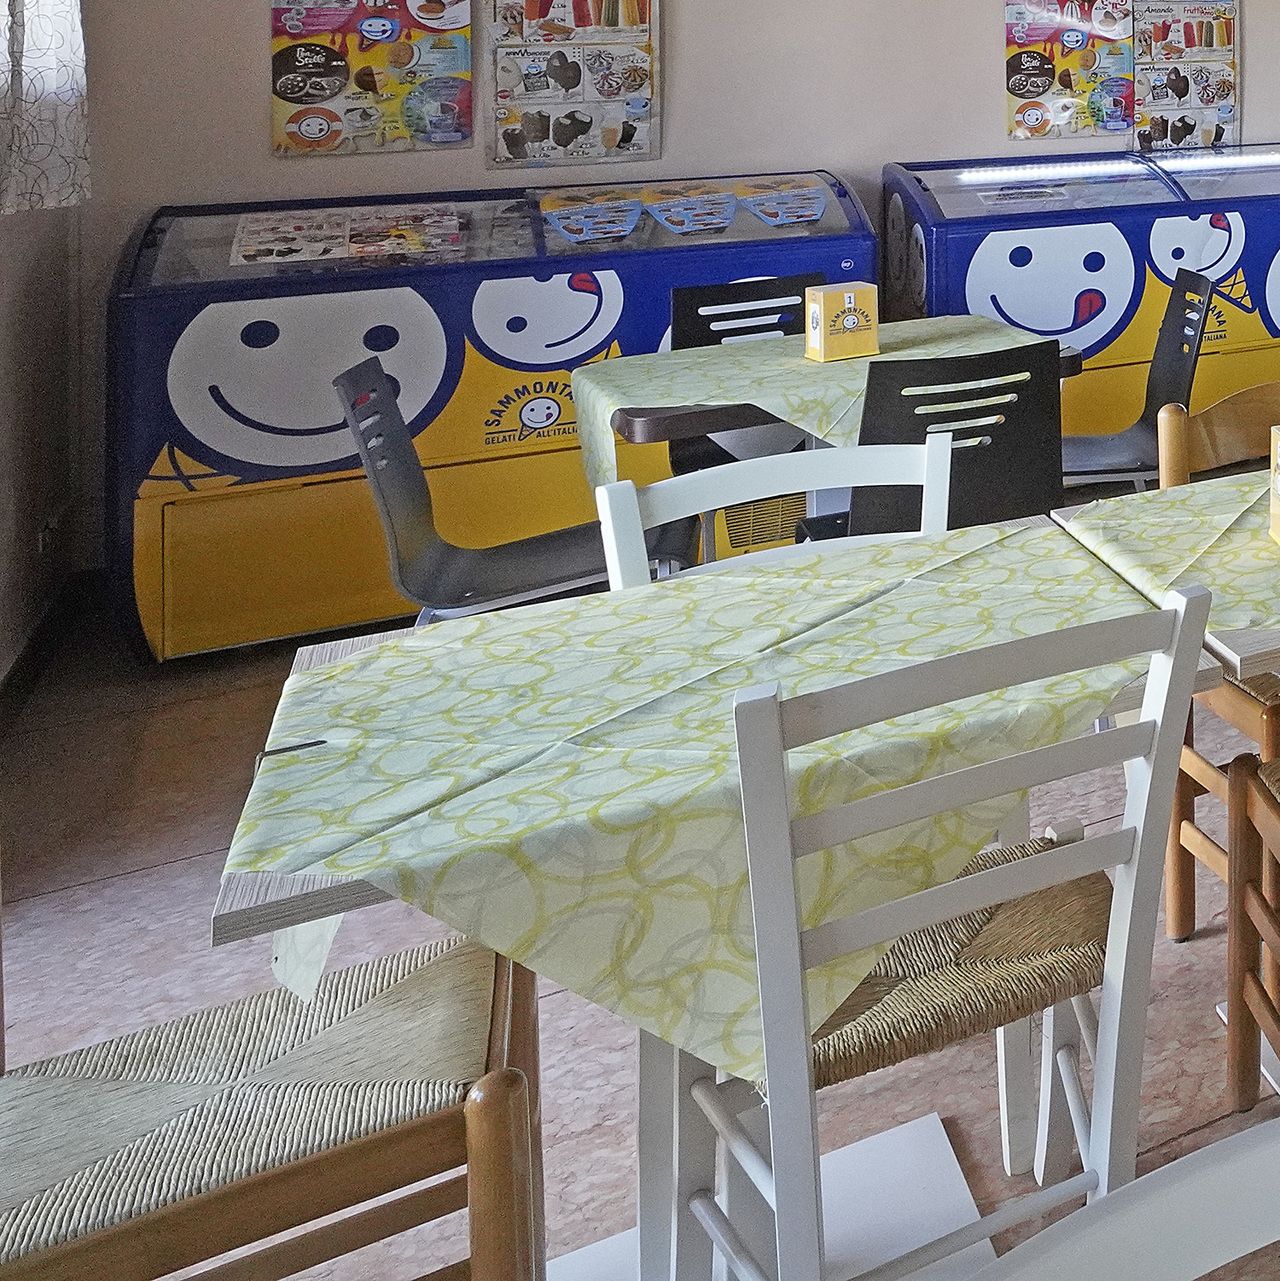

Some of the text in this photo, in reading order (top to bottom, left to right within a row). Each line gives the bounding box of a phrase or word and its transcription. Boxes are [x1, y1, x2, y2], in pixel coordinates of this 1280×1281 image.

[847, 295, 853, 305] 1
[829, 307, 872, 328] SAMMONTANA
[484, 381, 575, 428] SAMMONTA
[484, 426, 578, 446] GELATI ALL'ITALI
